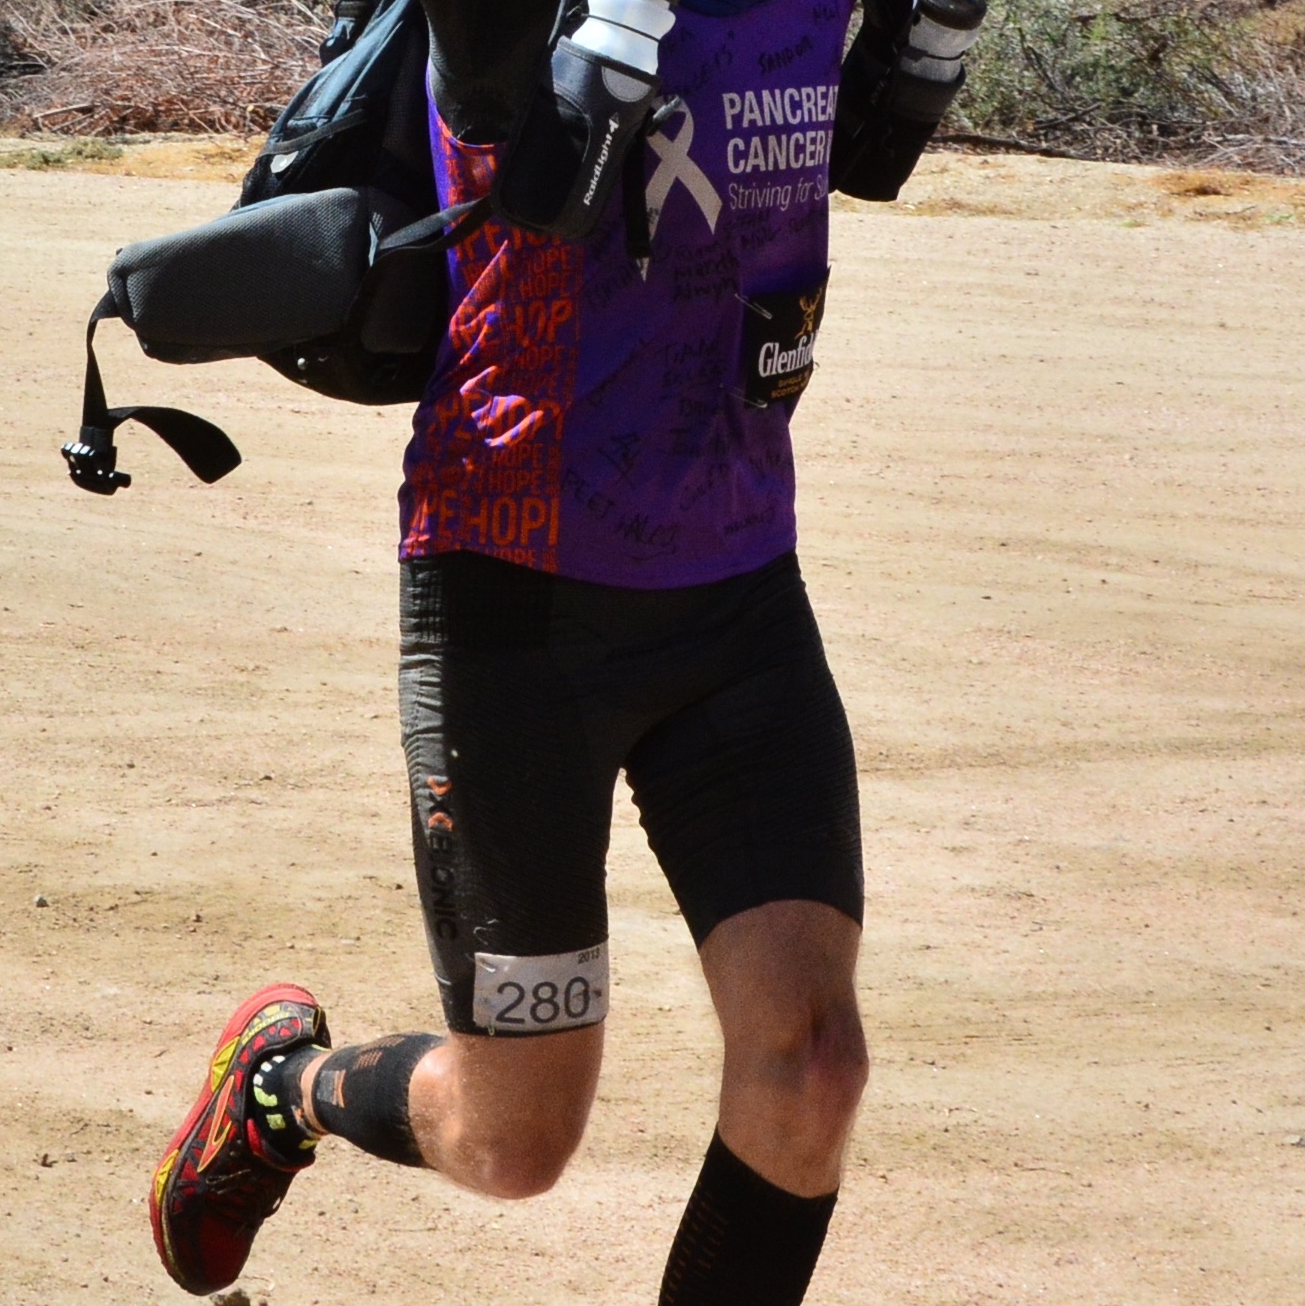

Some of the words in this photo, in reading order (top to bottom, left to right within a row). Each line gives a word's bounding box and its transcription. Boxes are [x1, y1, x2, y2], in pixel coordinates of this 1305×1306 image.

[583, 133, 613, 206] RaidLight
[727, 130, 826, 174] CANCER
[728, 181, 792, 212] Striving
[795, 177, 814, 203] for
[758, 332, 816, 378] Glenfid
